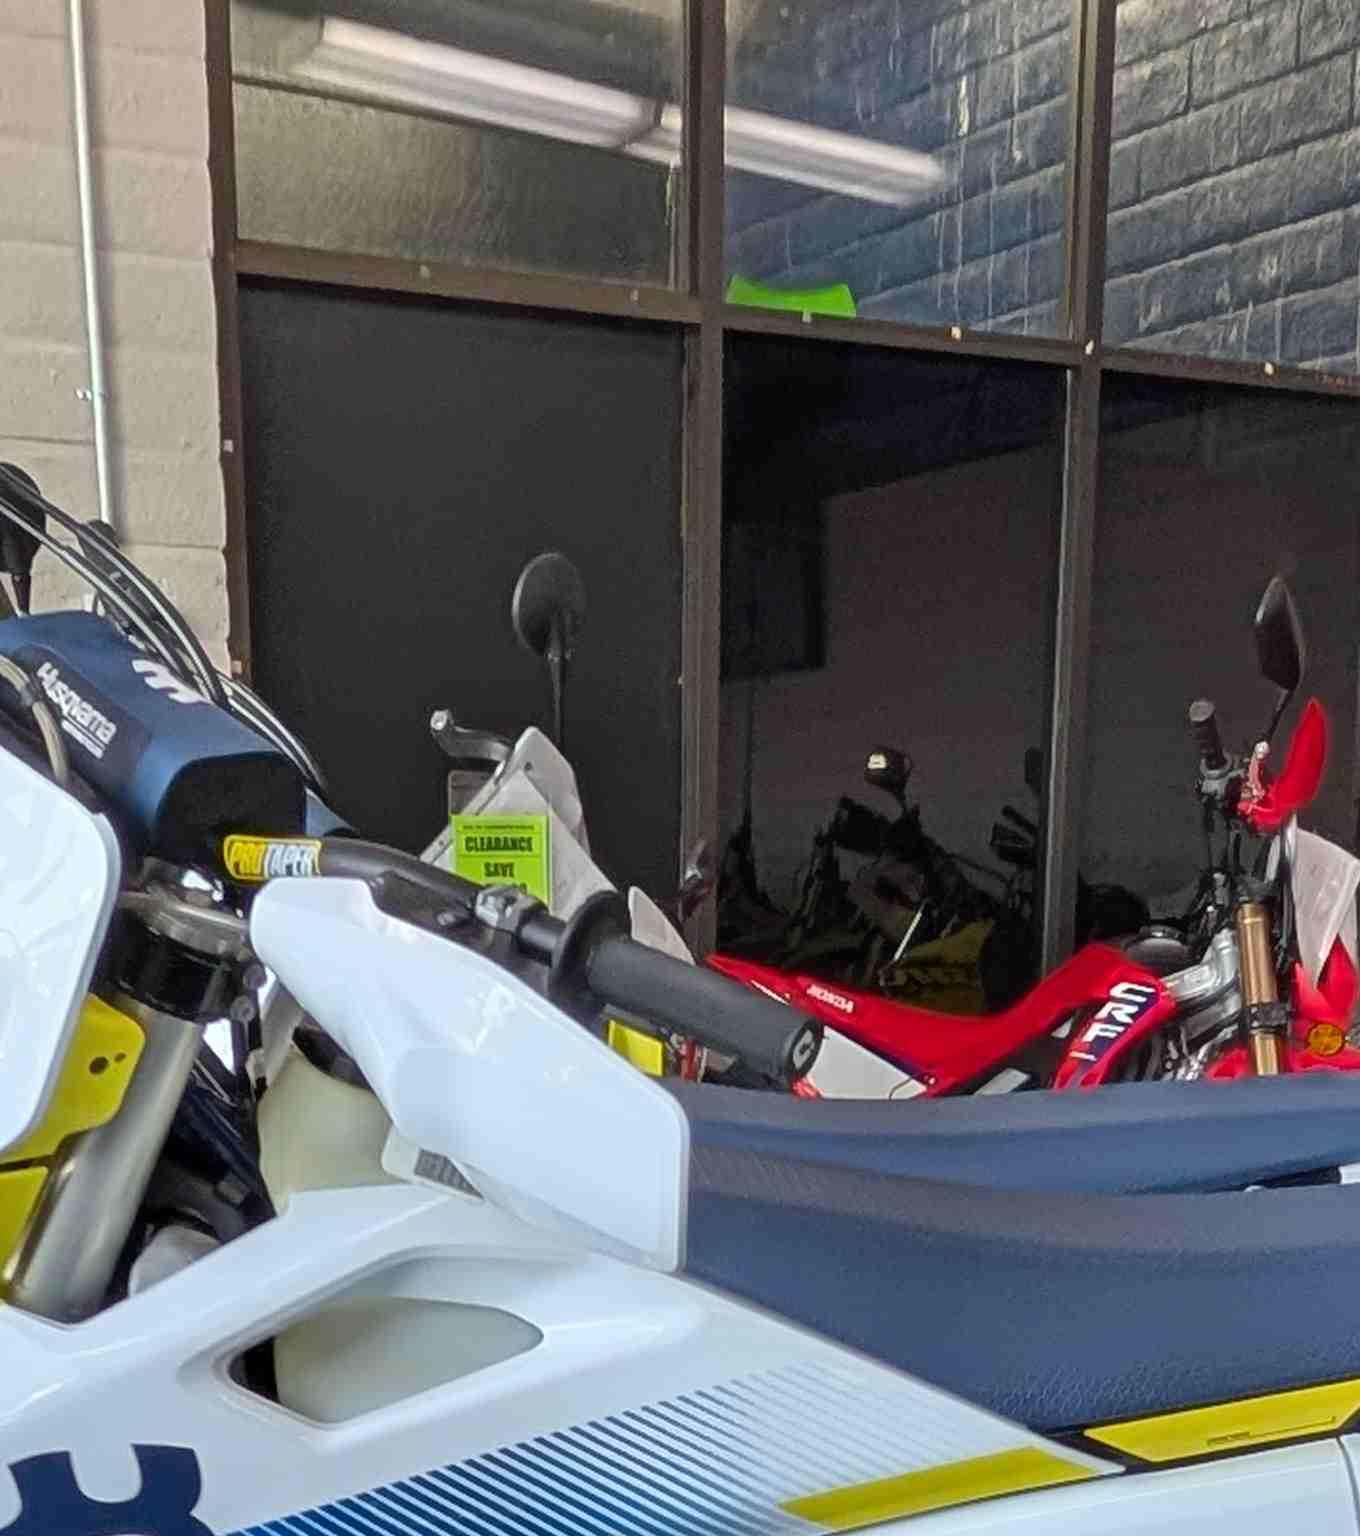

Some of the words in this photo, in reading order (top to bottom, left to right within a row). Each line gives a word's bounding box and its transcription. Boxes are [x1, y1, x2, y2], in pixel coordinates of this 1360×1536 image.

[37, 662, 118, 744] Husqvarna
[464, 836, 533, 852] CLEARANCE
[484, 861, 515, 878] SAVE
[806, 983, 854, 1014] HONDA
